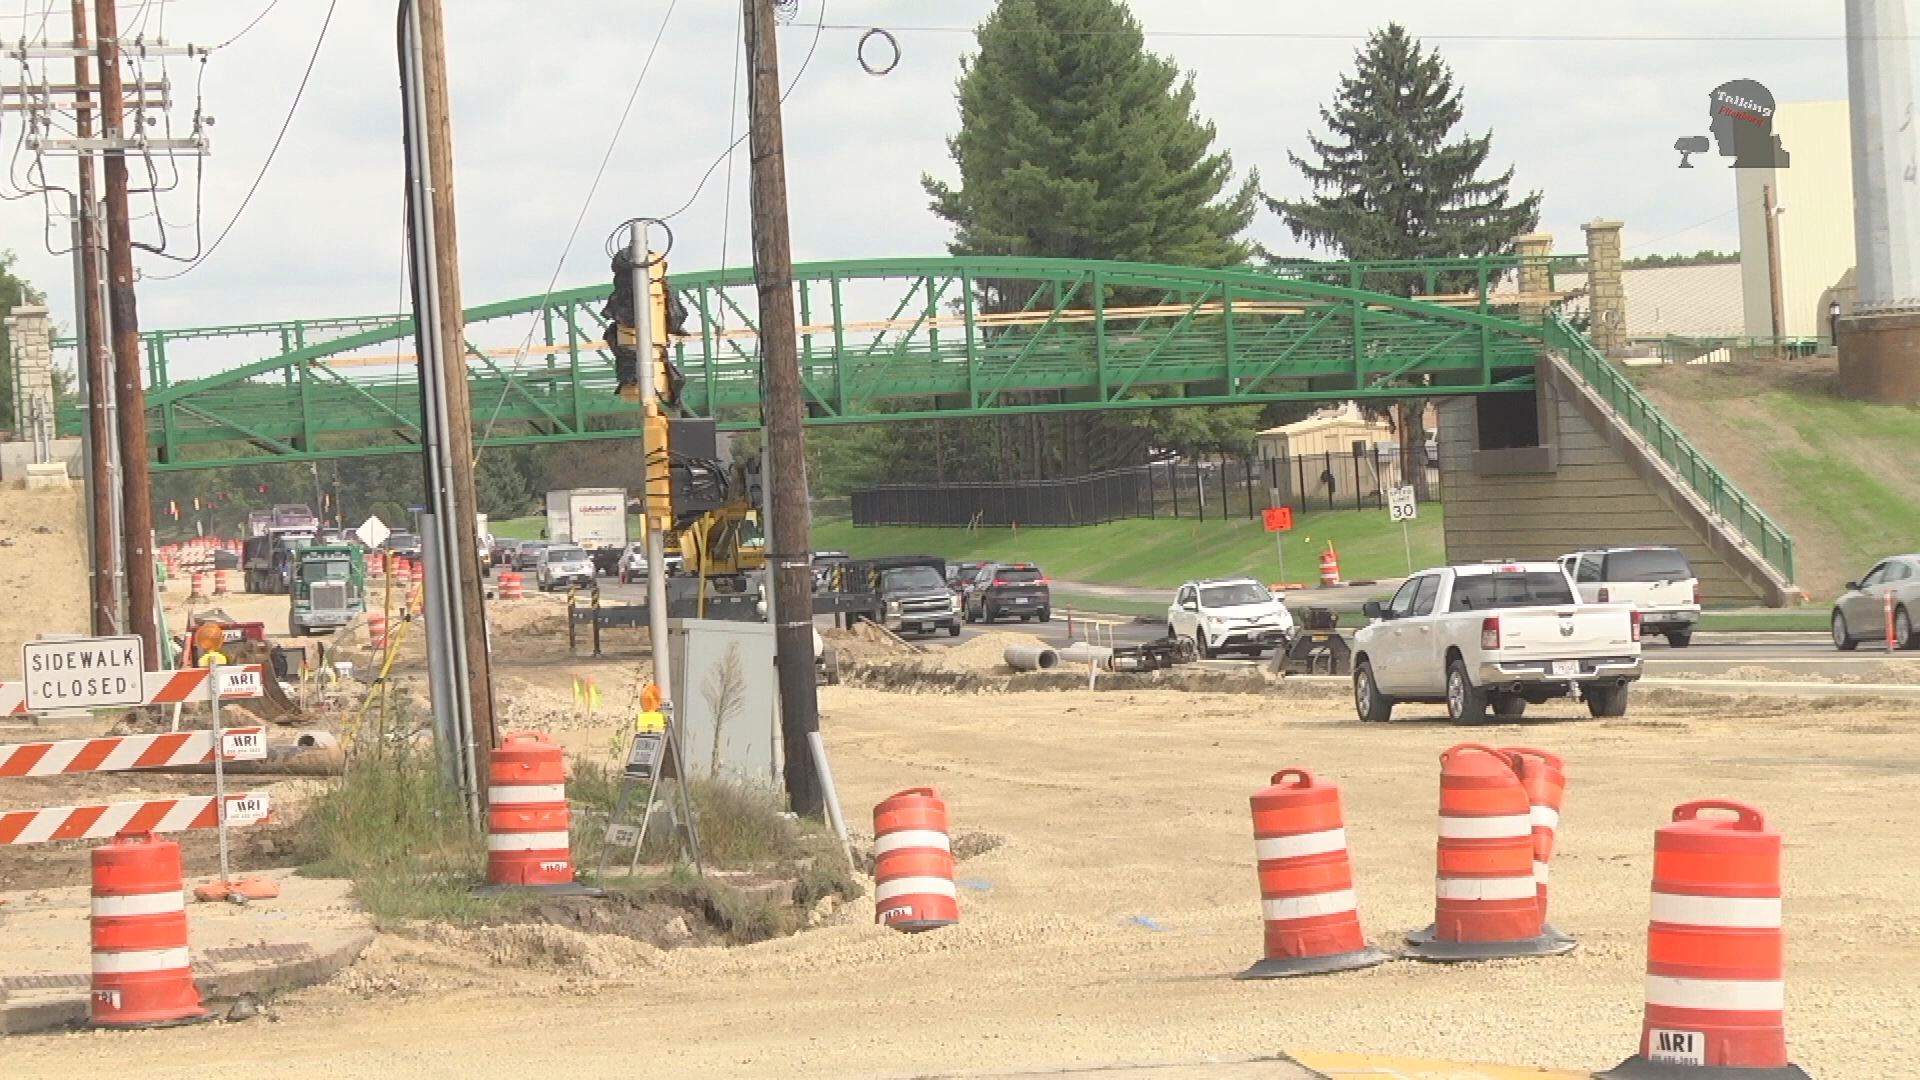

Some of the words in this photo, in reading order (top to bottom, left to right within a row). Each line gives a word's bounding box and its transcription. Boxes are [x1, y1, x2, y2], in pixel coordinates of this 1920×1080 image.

[1393, 503, 1414, 518] 30
[32, 648, 134, 672] SIDEWALK
[42, 677, 127, 699] CLOSED
